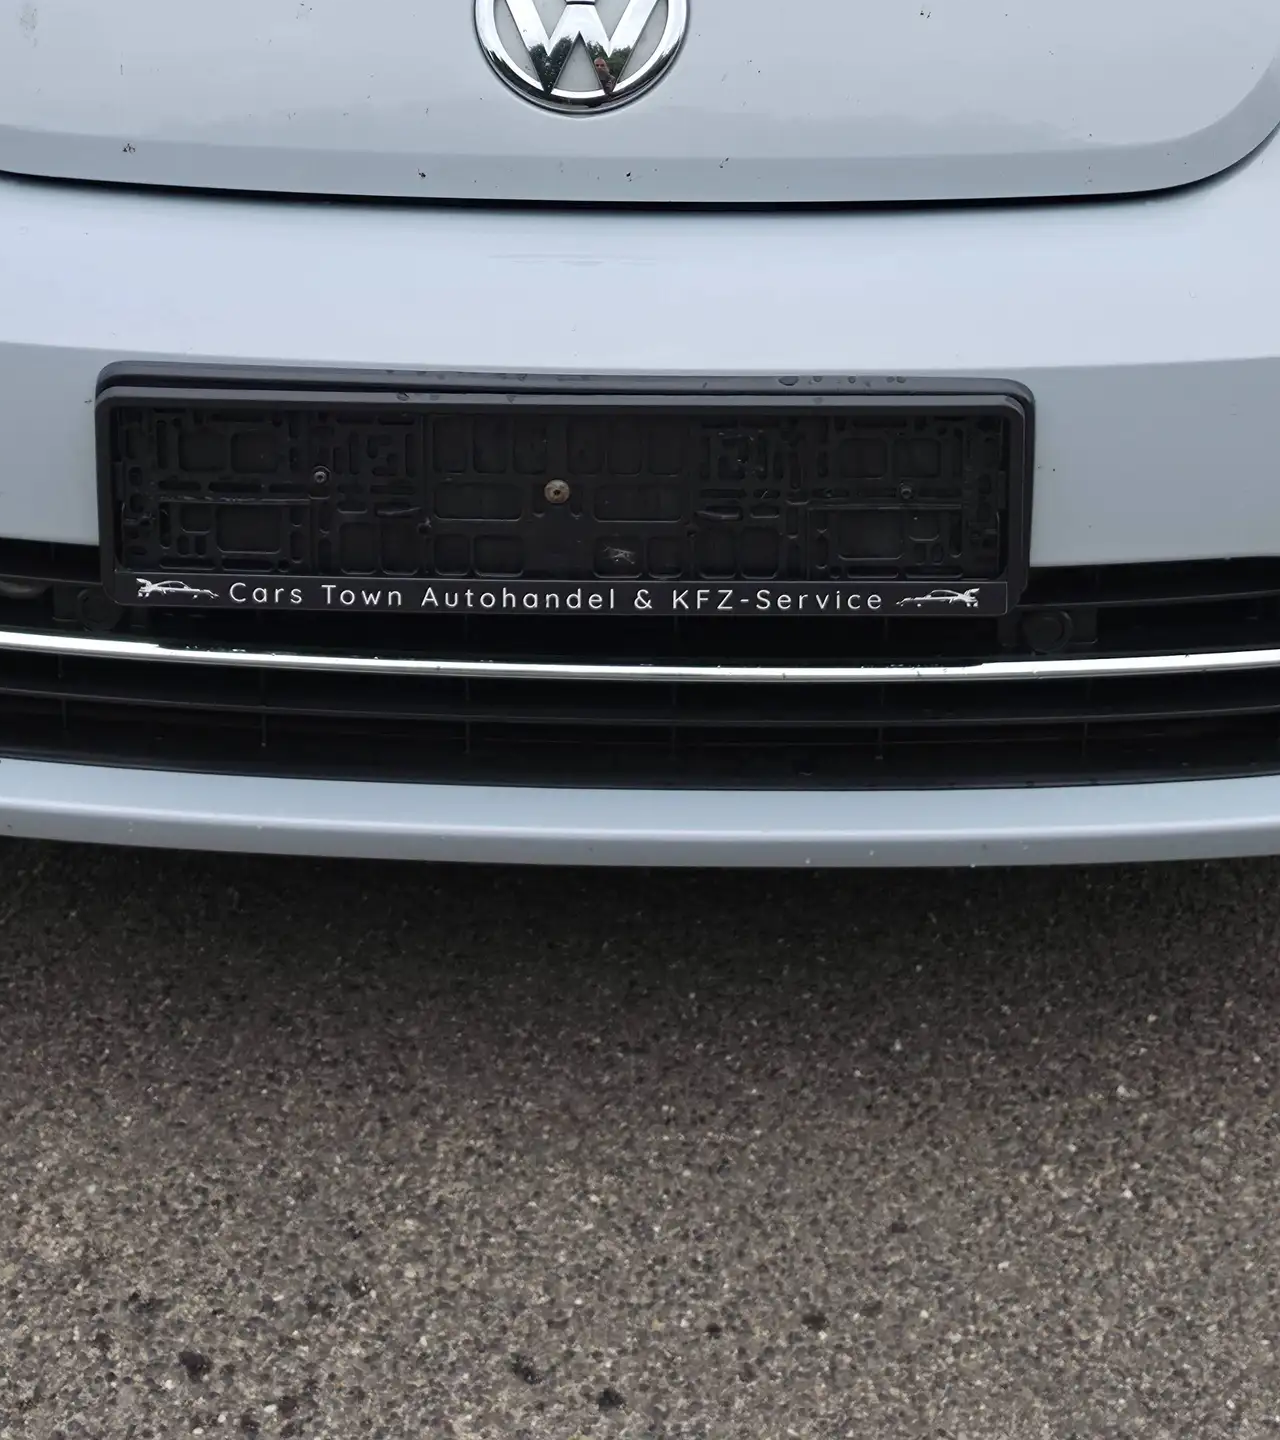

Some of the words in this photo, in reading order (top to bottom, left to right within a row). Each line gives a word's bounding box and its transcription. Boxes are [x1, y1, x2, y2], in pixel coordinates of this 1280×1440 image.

[228, 581, 304, 605] Cars
[320, 583, 404, 608] Town
[421, 585, 616, 611] Autohandel
[633, 588, 654, 611] &
[672, 587, 884, 611] KFZ-Service
